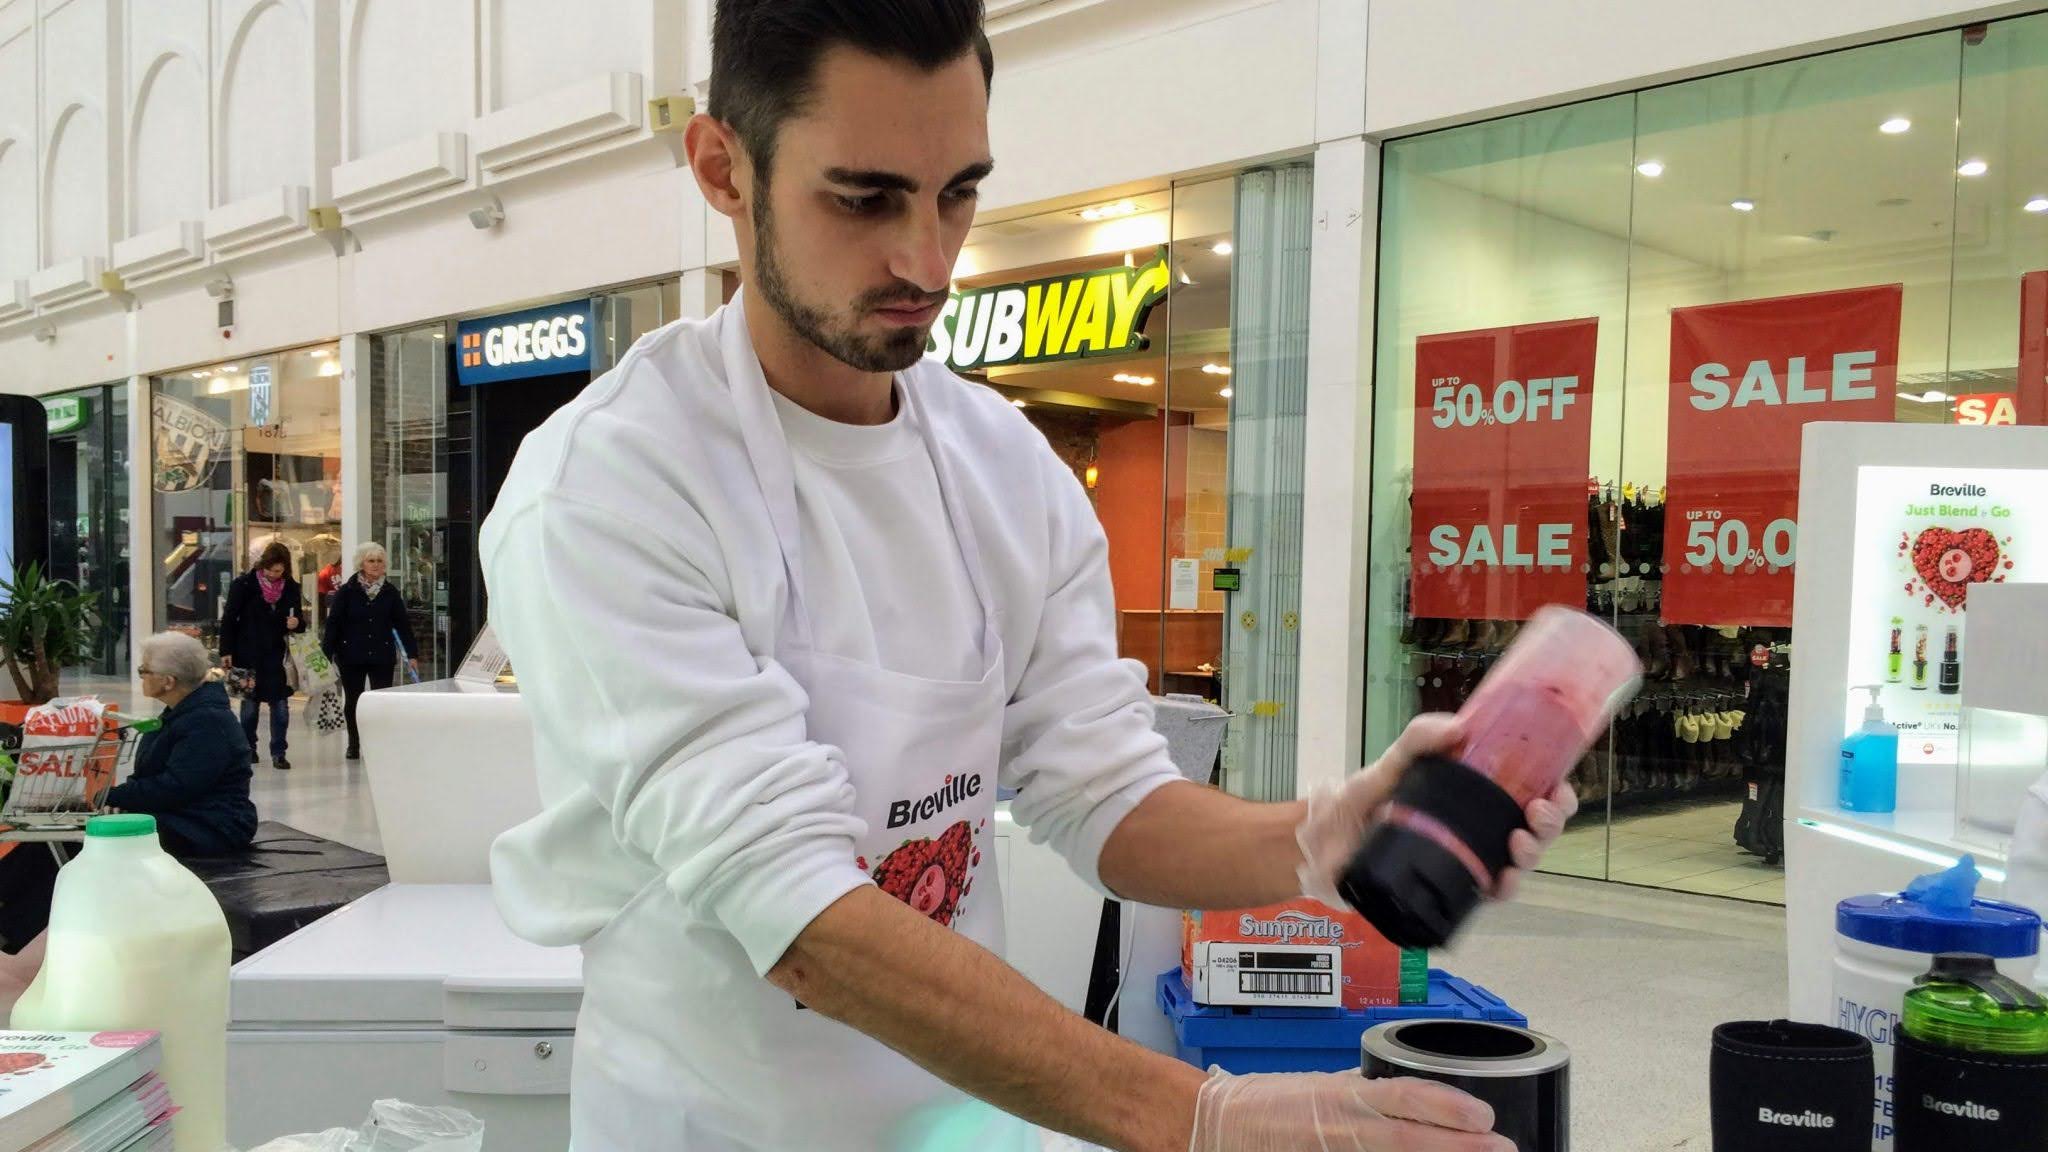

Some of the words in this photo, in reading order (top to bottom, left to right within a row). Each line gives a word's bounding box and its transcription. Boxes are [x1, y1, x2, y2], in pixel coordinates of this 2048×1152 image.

[923, 258, 1170, 367] SUBWAY
[484, 314, 586, 367] GREGGS
[1432, 378, 1445, 387] UP
[1446, 376, 1460, 385] TO
[1689, 350, 1877, 411] SALE
[1930, 483, 1987, 497] Breville
[1686, 511, 1703, 520] UP
[1706, 510, 1722, 520] TO
[1905, 504, 1936, 517] Just
[1939, 504, 1978, 517] Blend
[1991, 505, 2011, 518] Go
[1428, 523, 1573, 567] SALE
[886, 773, 981, 829] Breville
[1239, 911, 1345, 943] Sunpride
[1758, 1107, 1835, 1129] Breville
[1921, 1094, 2000, 1122] Breville
